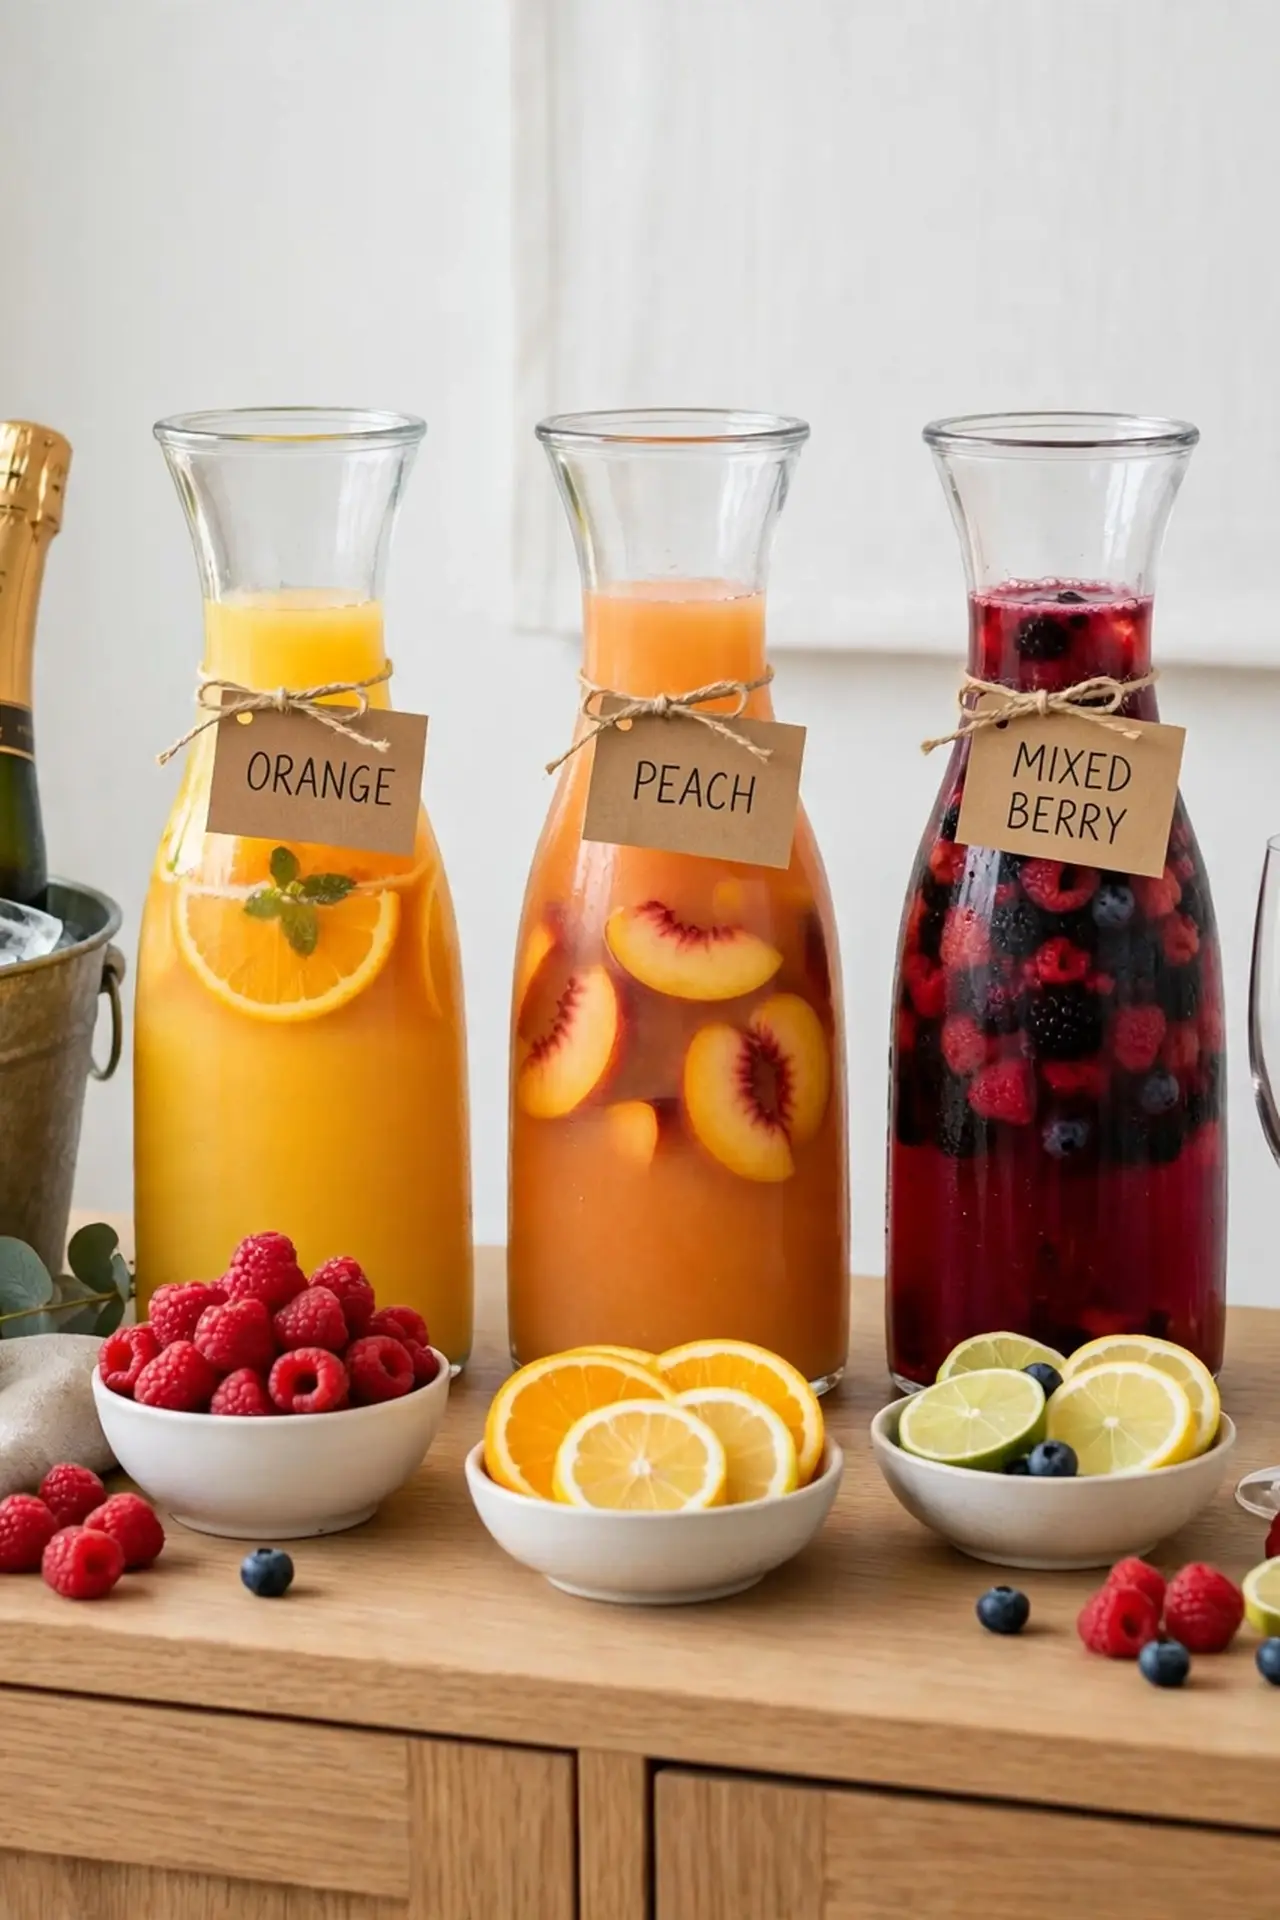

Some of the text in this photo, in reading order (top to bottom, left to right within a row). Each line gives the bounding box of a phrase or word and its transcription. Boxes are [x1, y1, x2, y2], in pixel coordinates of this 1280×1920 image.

[246, 751, 397, 806] ORANGE
[632, 760, 757, 814] PEACH
[1012, 741, 1132, 792] MIXED
[1006, 791, 1128, 845] BERRY
